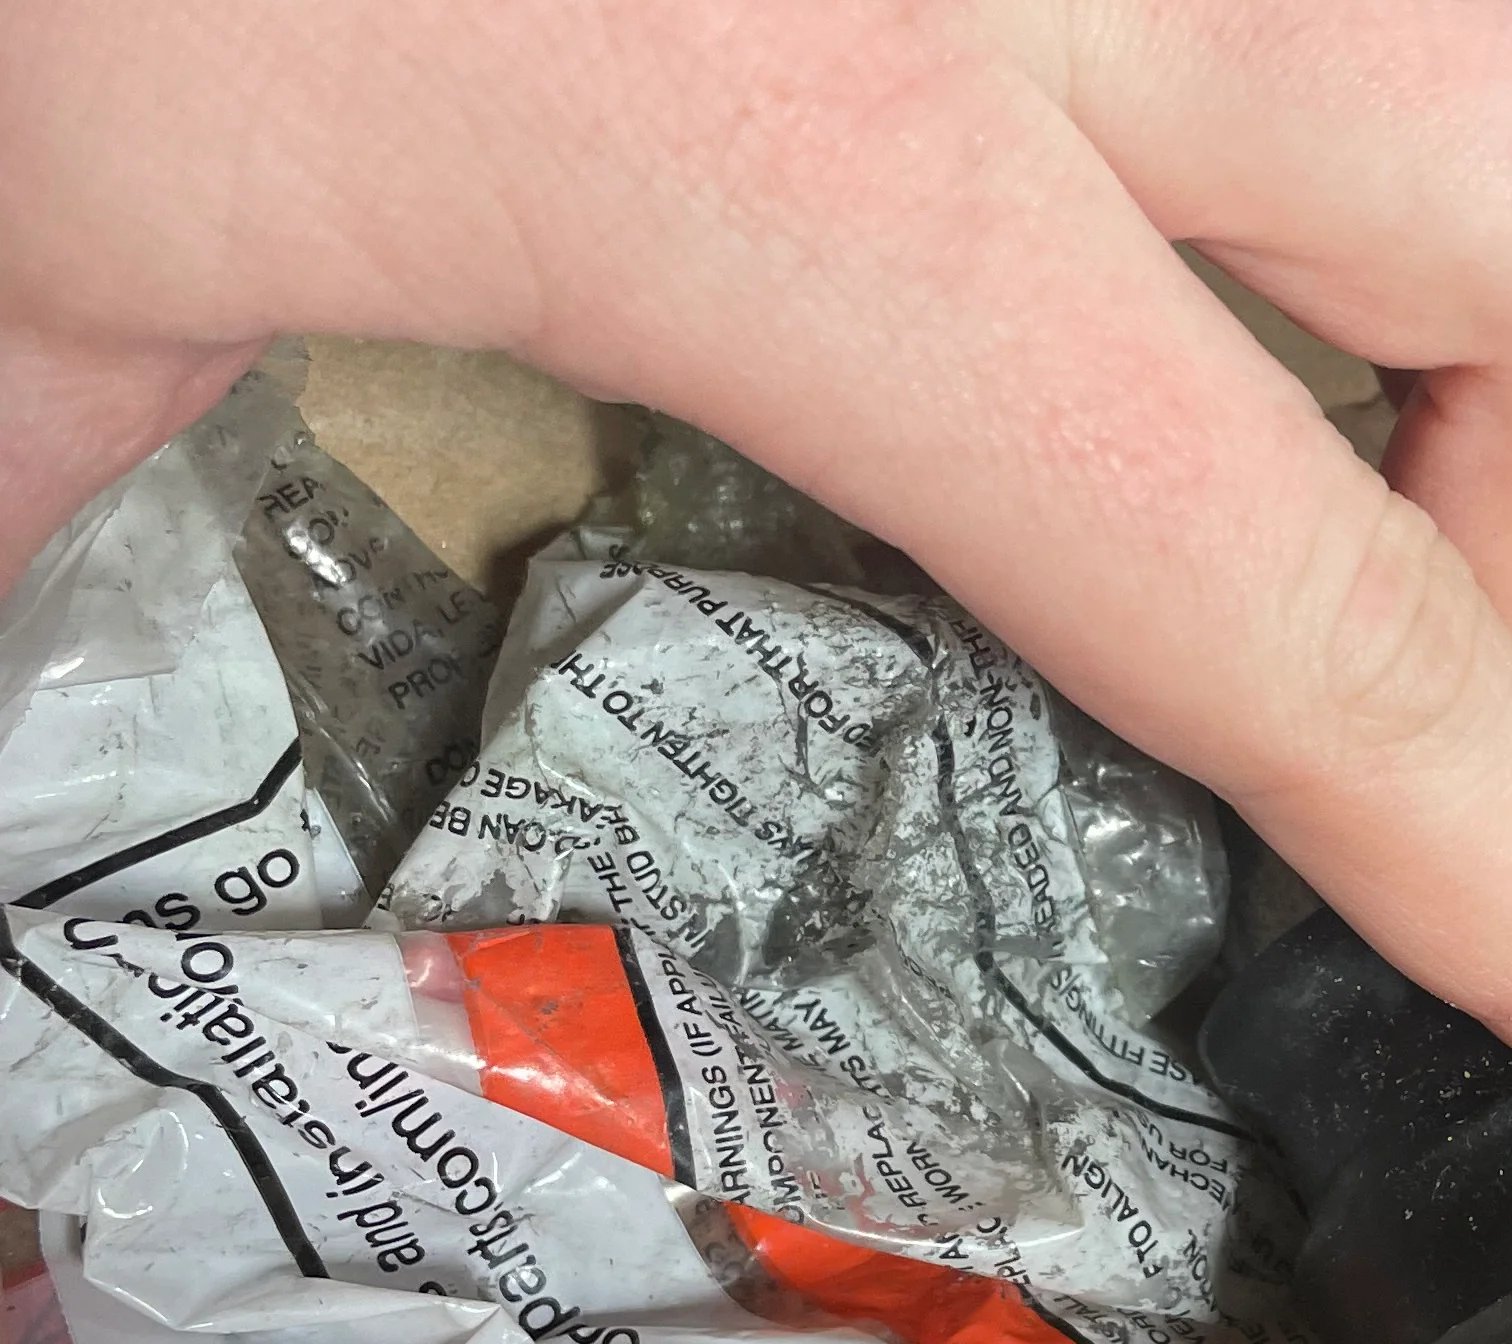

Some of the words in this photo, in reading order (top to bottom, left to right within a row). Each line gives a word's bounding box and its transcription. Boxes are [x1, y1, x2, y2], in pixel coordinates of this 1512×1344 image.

[715, 608, 792, 681] THAT
[602, 689, 646, 732] TO
[786, 668, 849, 736] FOR
[641, 721, 755, 828] TIGHTEN
[987, 755, 1025, 819] AND
[211, 849, 299, 915] go
[587, 852, 631, 912] THE
[626, 851, 687, 921] STUD
[793, 998, 850, 1056] MAY
[701, 1063, 751, 1201] ARNINGS
[1169, 1141, 1227, 1171] FOR
[1060, 1150, 1139, 1220] ALIGN
[337, 1197, 427, 1274] and
[1126, 1223, 1157, 1258] TO
